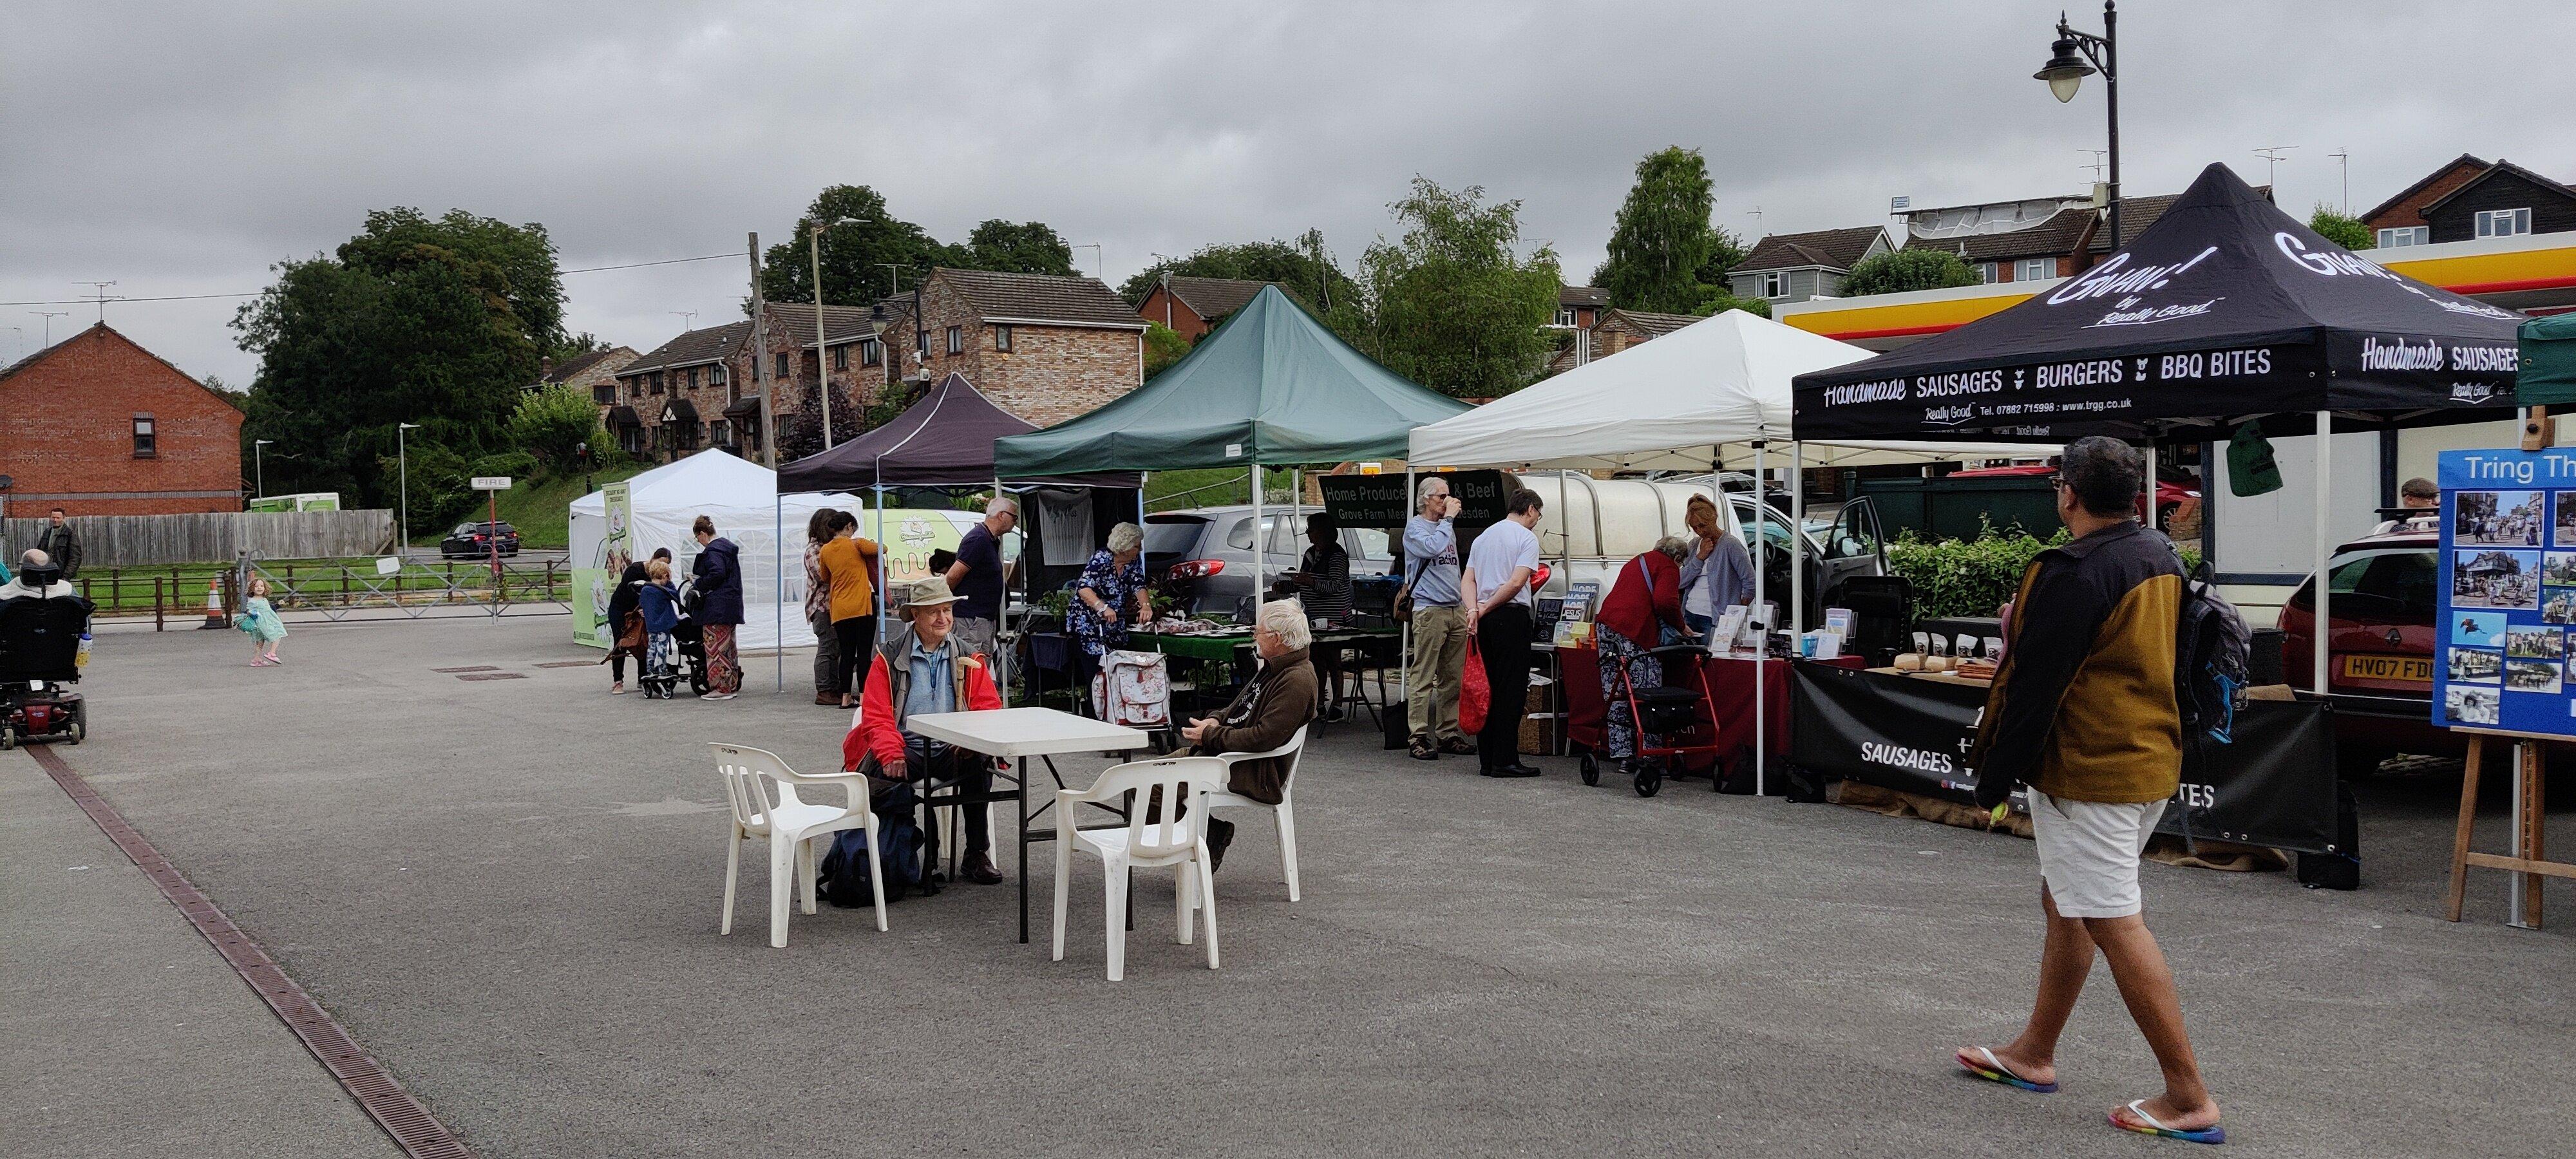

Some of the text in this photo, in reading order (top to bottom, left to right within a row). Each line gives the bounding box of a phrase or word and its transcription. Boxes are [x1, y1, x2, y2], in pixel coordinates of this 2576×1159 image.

[2096, 299, 2215, 325] Really Good
[2361, 337, 2445, 372] Handmade
[1823, 348, 2271, 408] Handmade SAUSAGES BURGERS BBQ BITES
[2452, 382, 2474, 399] Really
[1926, 406, 1949, 421] Really
[1950, 404, 1971, 419] Good
[1980, 406, 1994, 415] Tel.
[2465, 457, 2534, 484] Tring
[1326, 486, 1356, 502] Home
[1454, 483, 1463, 499] &
[1466, 482, 1495, 498] Beef
[1338, 509, 1363, 520] Grove
[1364, 509, 1385, 520] Farm
[2353, 659, 2400, 676] HV07
[1861, 741, 1953, 774] SAUSAGES
